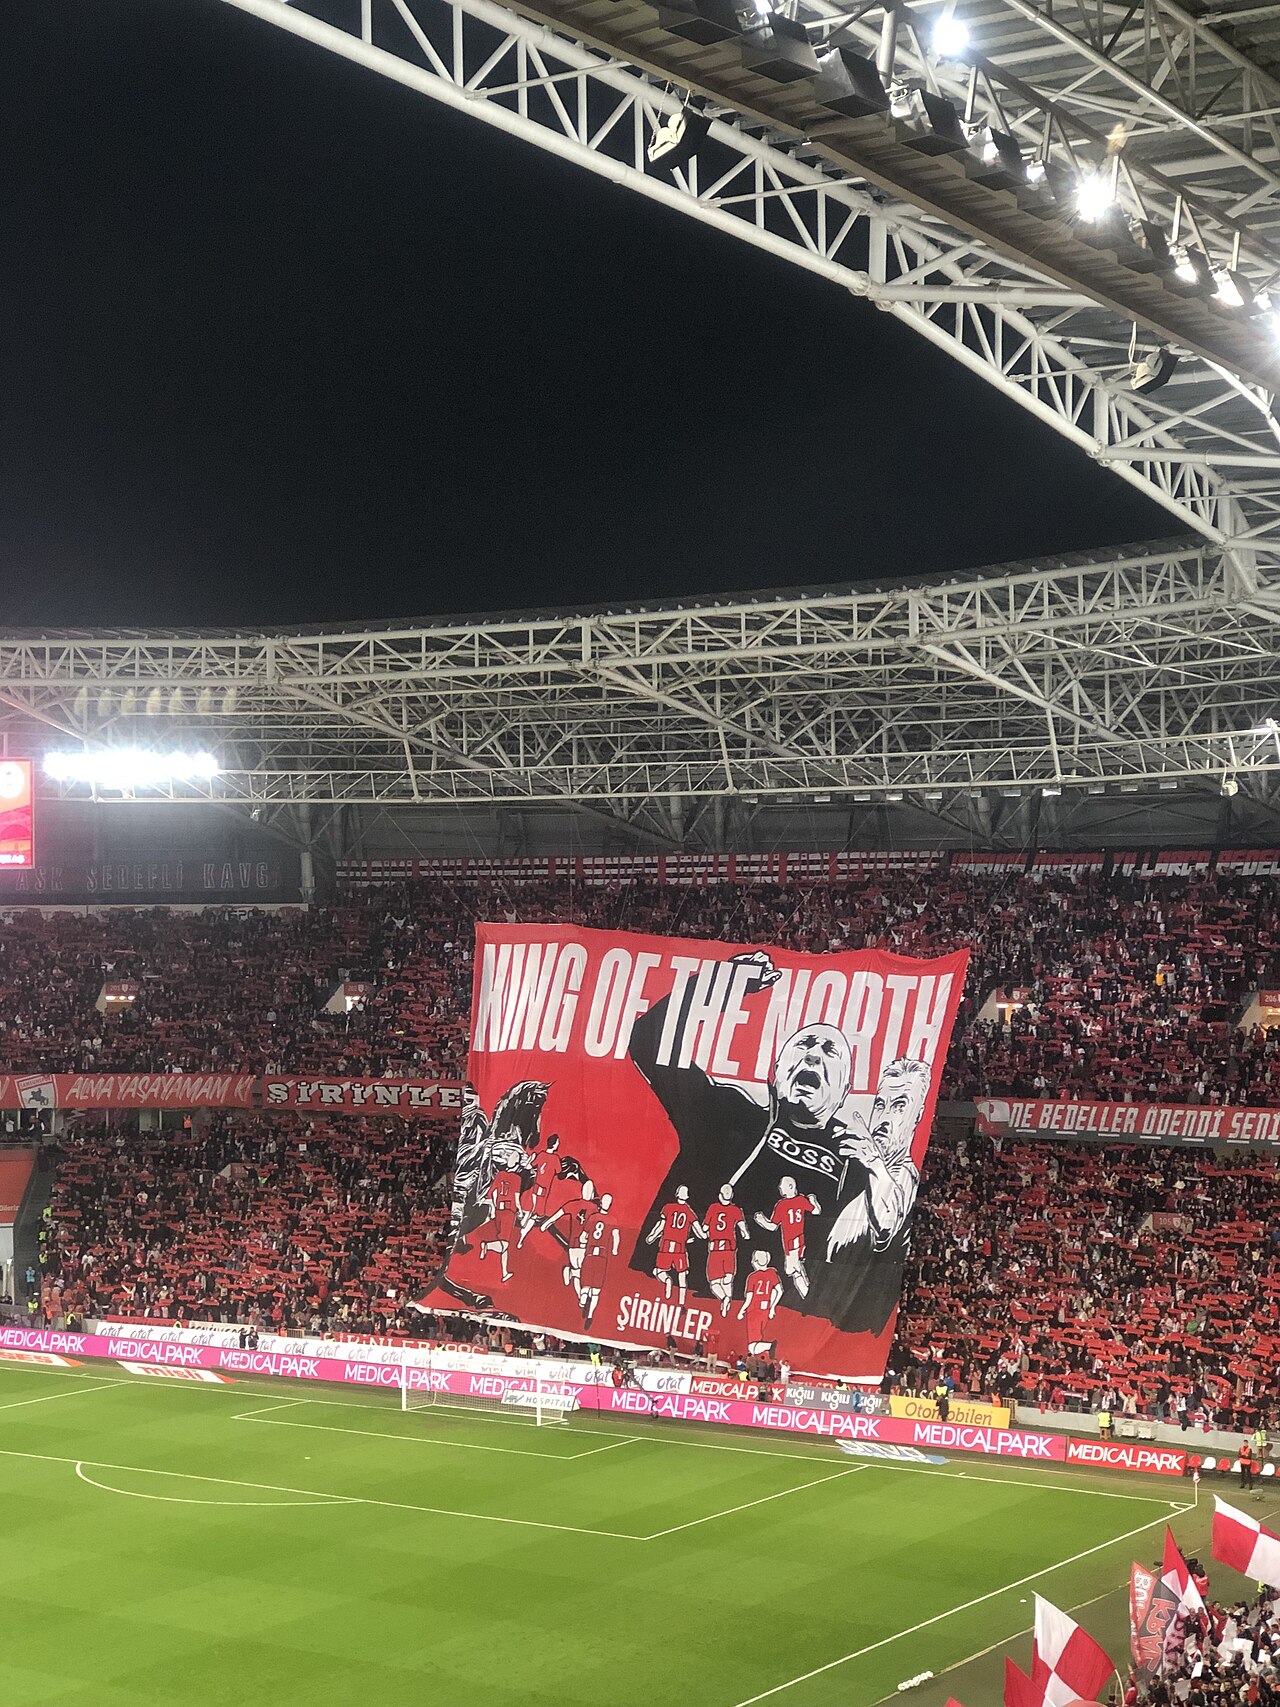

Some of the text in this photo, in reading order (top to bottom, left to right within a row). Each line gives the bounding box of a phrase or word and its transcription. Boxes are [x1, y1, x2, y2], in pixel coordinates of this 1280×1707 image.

[473, 943, 954, 1093] KING OF THE NORTH
[65, 1076, 113, 1101] ALMA
[117, 1075, 233, 1104] YAŞAYAMAM
[266, 1080, 464, 1110] ŞİRİNLE
[1038, 1103, 1139, 1133] BEDELLER
[1141, 1106, 1226, 1138] ÖDENDİ
[767, 1132, 836, 1173] BOSS
[593, 1221, 605, 1240] 8
[671, 1211, 687, 1229] 10
[716, 1213, 727, 1232] 5
[787, 1208, 802, 1224] 18
[755, 1280, 770, 1295] 21
[616, 1292, 713, 1342] ŞİRİNLER
[222, 1336, 240, 1349] ota
[657, 1374, 685, 1390] otat
[107, 1340, 204, 1365] MEDICALPARK
[219, 1351, 320, 1378] MEDICALPARK
[752, 1404, 882, 1439] MEDICALPARK
[914, 1422, 1053, 1458] MEDICALPARK
[525, 1396, 572, 1409] HOSPITAL
[690, 1380, 785, 1402] MEDICALPK
[1067, 1443, 1185, 1472] MEDICALPARK
